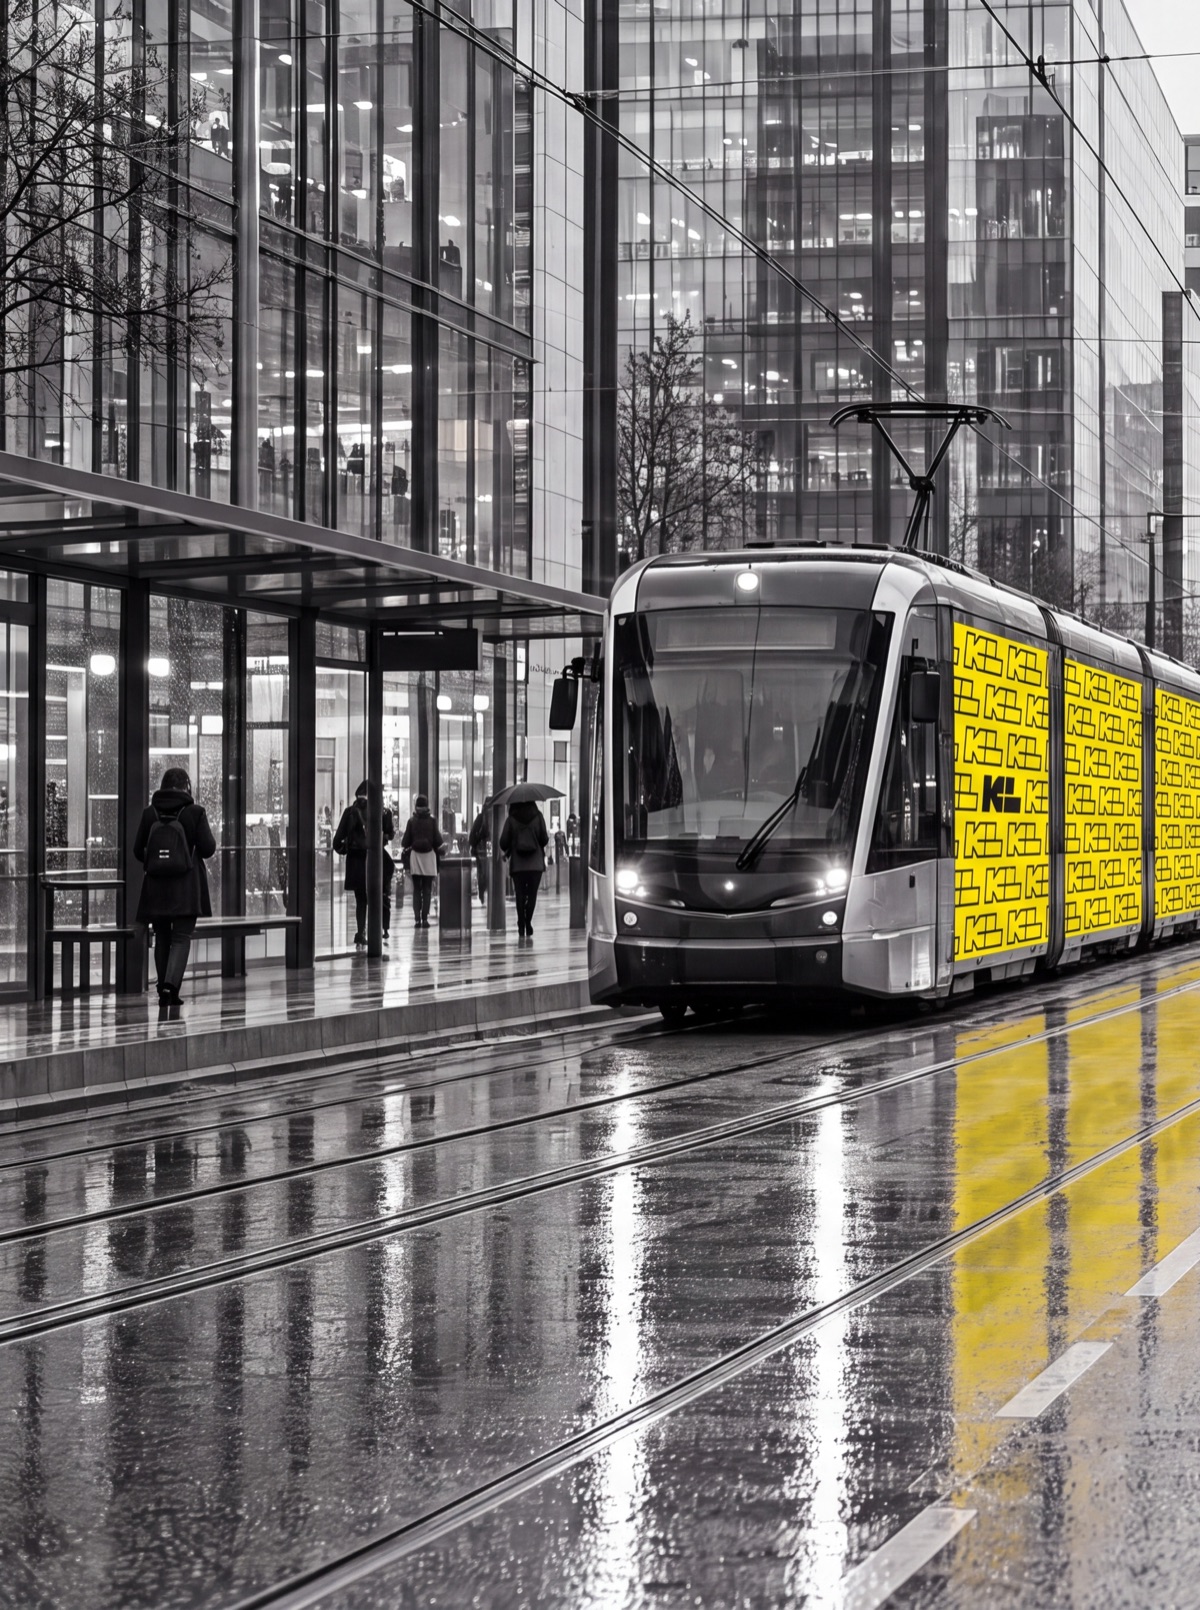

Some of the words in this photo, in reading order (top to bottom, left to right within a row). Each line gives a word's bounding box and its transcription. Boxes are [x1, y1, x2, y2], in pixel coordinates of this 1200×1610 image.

[964, 631, 1003, 677] KL
[1007, 645, 1042, 687] KL
[954, 676, 980, 717] L
[984, 684, 1022, 725] KL
[1065, 663, 1081, 697] L
[1084, 670, 1111, 705] KL
[1113, 679, 1138, 713] KL
[1067, 703, 1096, 739] KL
[1098, 711, 1125, 745] KL
[1156, 726, 1171, 754] L
[963, 726, 1003, 767] KL
[1006, 733, 1042, 771] KL
[1065, 743, 1080, 775] L
[1083, 746, 1111, 779] KL
[1113, 751, 1139, 782] KL
[955, 773, 978, 812] L
[982, 775, 1021, 813] KL
[1067, 783, 1096, 815] KL
[1098, 786, 1124, 816] KL
[1155, 792, 1171, 817] L
[964, 821, 1003, 859] KL
[1006, 822, 1041, 857] KL
[1065, 823, 1081, 853] L
[1084, 823, 1111, 853] KL
[1114, 823, 1139, 851] KL
[955, 869, 980, 908] L
[984, 866, 1022, 904] KL
[1067, 861, 1096, 894] KL
[1099, 859, 1125, 890] KL
[1155, 856, 1172, 882] L
[964, 913, 1003, 953] KL
[1007, 907, 1042, 945] KL
[1065, 902, 1081, 933] L
[1084, 897, 1111, 930] KL
[1114, 893, 1139, 924] KL
